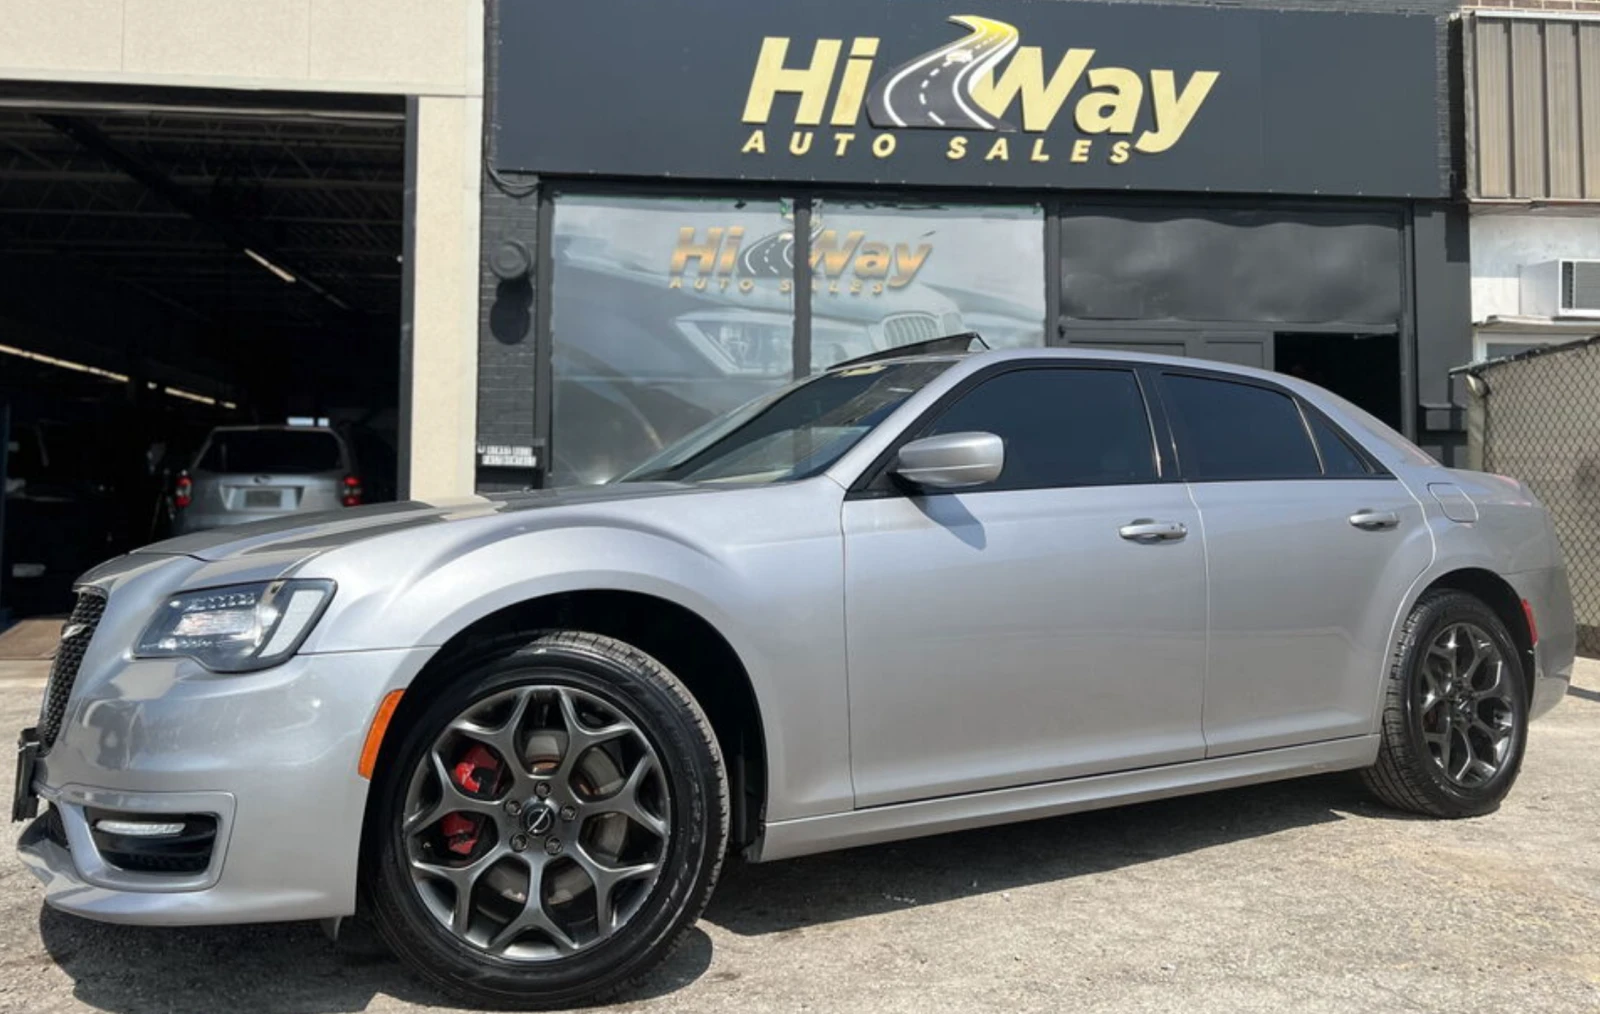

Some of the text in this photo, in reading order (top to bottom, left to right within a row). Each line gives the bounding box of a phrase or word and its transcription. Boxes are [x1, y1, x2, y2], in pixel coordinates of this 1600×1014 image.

[741, 36, 1220, 154] Hi Way
[741, 130, 1133, 165] AUTO SALES
[668, 226, 933, 289] Hi Way
[669, 278, 756, 292] AUTO
